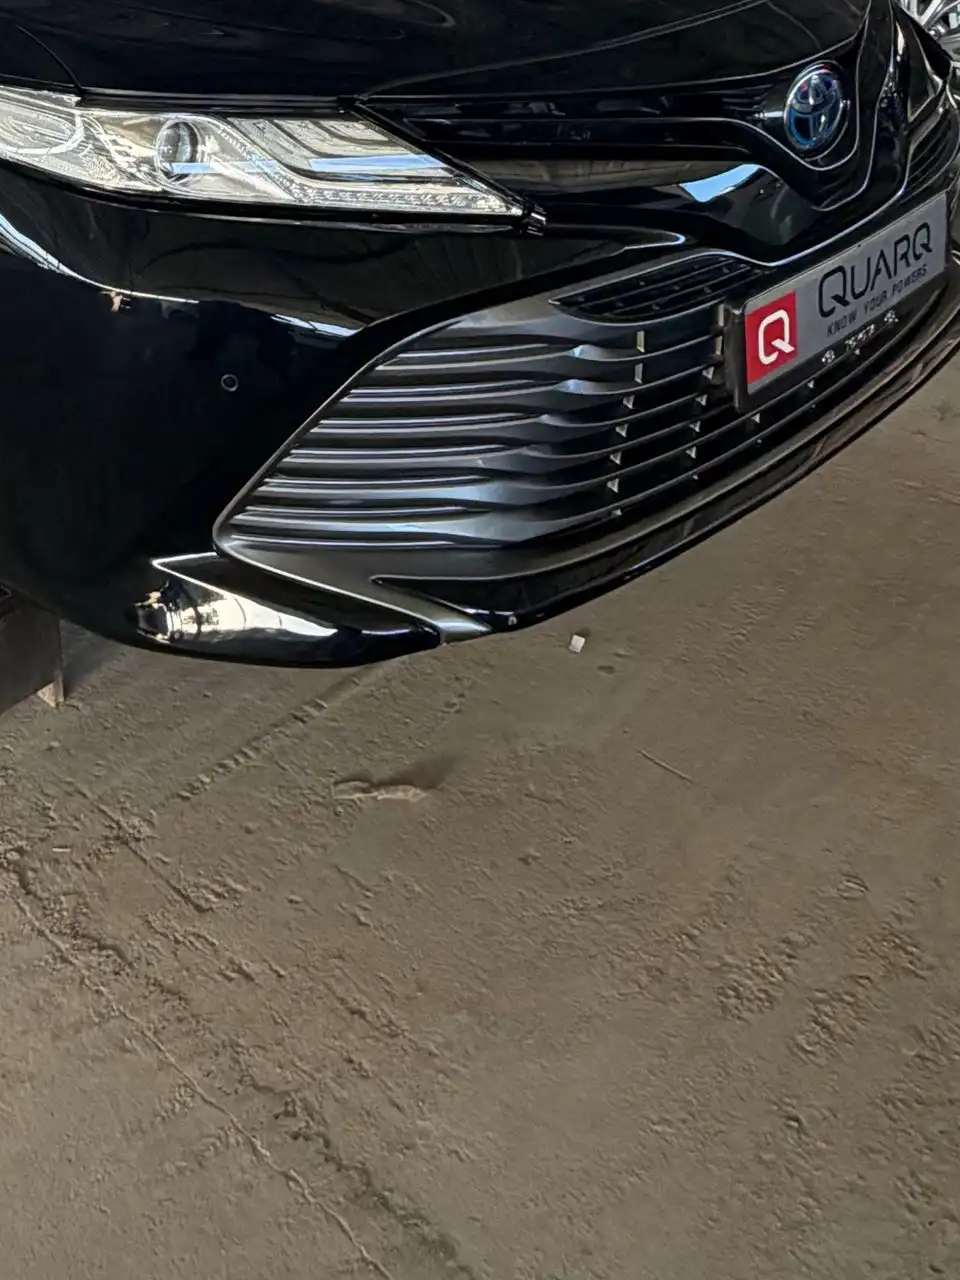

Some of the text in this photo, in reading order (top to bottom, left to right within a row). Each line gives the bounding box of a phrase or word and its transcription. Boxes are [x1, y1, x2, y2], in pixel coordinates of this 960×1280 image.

[818, 222, 932, 318] QUARQ
[827, 308, 858, 338] KNOW
[864, 290, 888, 315] YOUR
